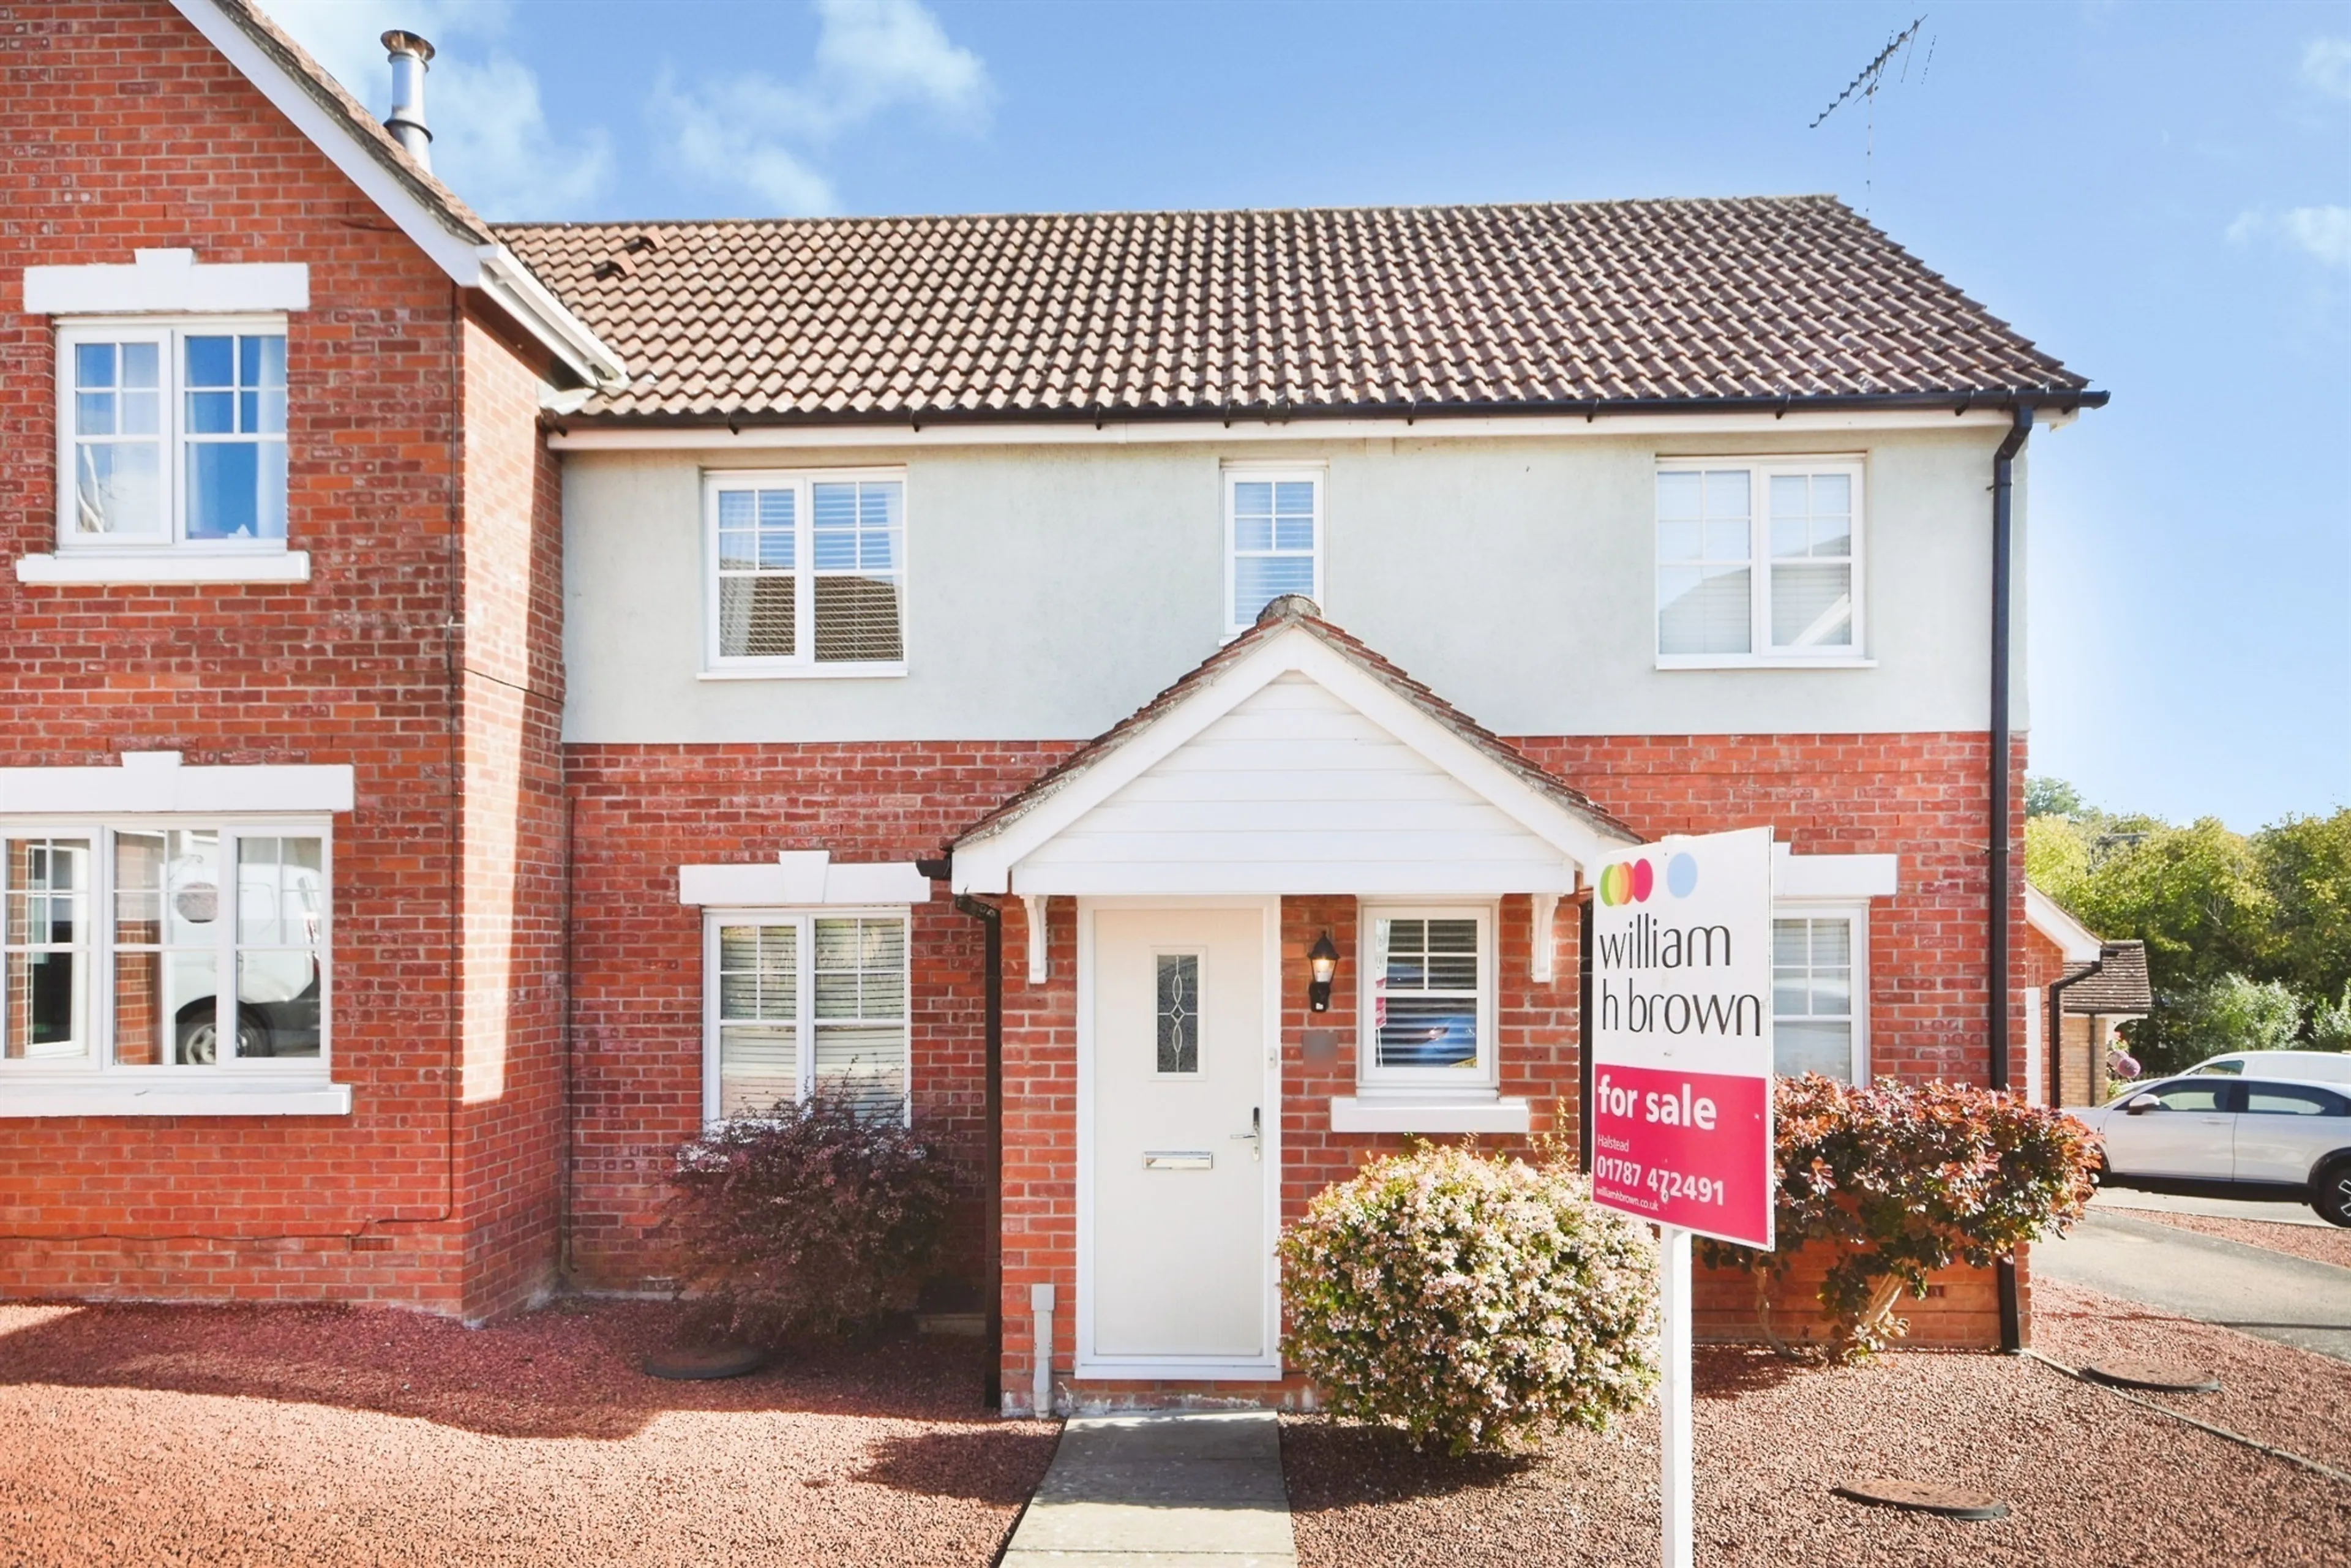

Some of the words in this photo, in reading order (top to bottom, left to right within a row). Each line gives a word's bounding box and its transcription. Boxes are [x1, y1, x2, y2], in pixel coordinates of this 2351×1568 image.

[1599, 913, 1731, 969] william
[1603, 978, 1618, 1030] h
[1629, 978, 1761, 1036] brown
[1598, 1075, 1638, 1118] for
[1646, 1083, 1717, 1130] sale
[1598, 1135, 1629, 1152] Halstead
[1595, 1186, 1659, 1211] williamhbrown.co.uk
[1597, 1155, 1641, 1187] 01787
[1647, 1168, 1724, 1206] 472491
